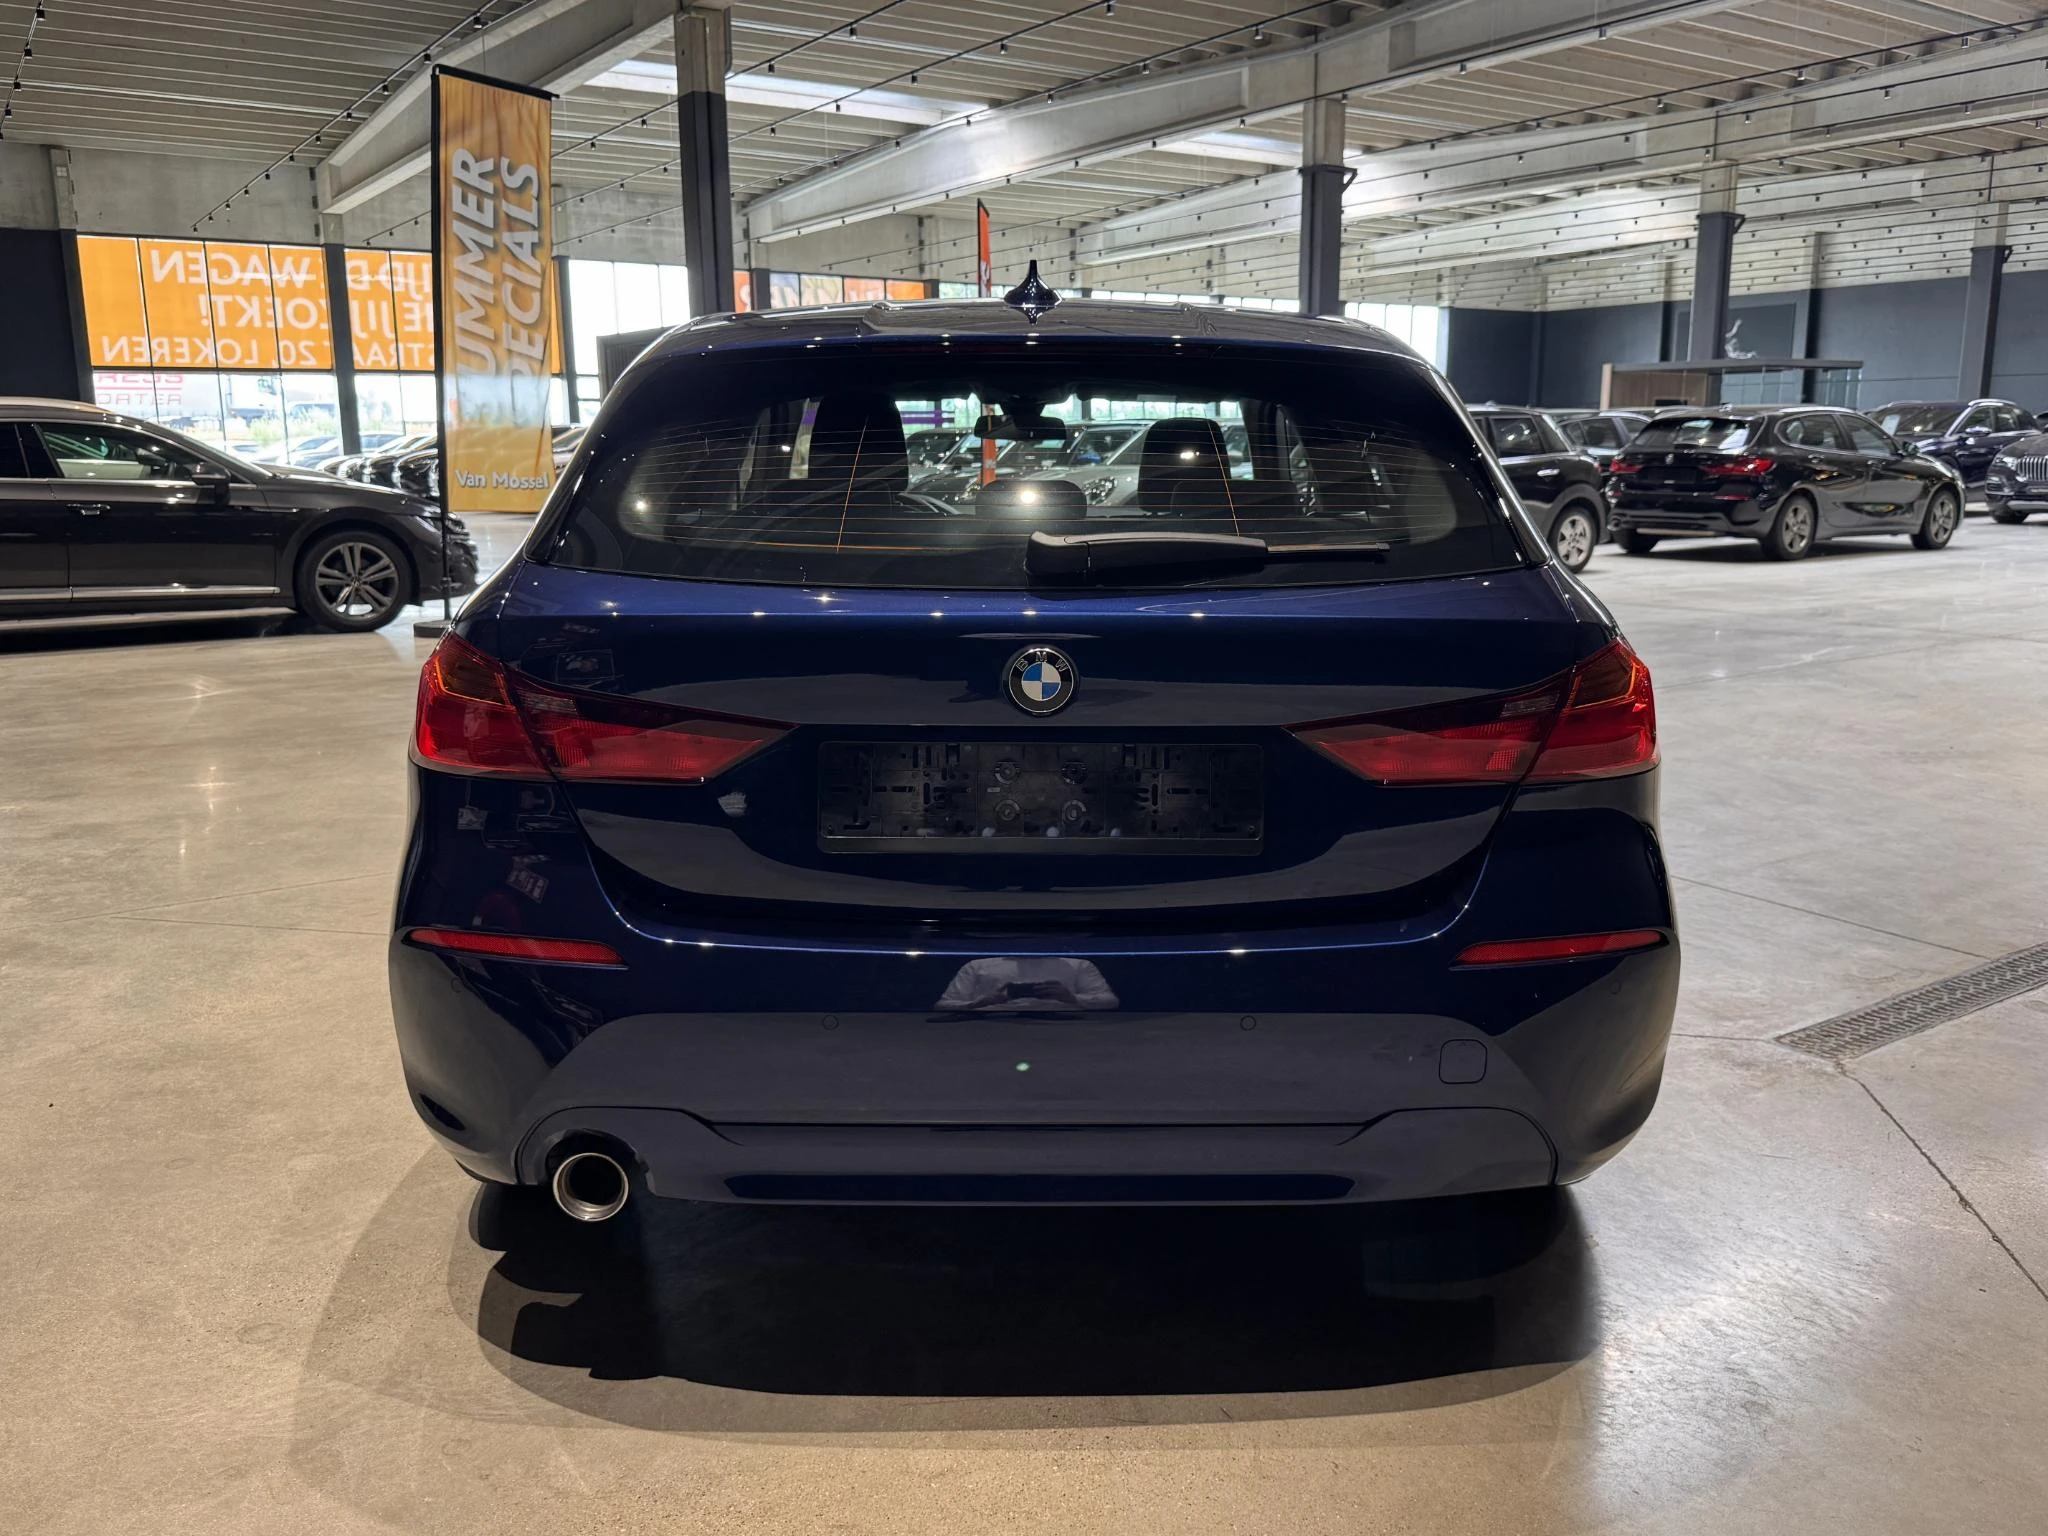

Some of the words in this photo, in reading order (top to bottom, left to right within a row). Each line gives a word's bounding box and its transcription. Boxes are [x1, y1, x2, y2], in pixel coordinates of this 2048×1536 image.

[452, 148, 497, 379] UMMER
[455, 469, 487, 488] Van
[492, 470, 550, 489] Mossel
[1015, 651, 1070, 672] BMW
